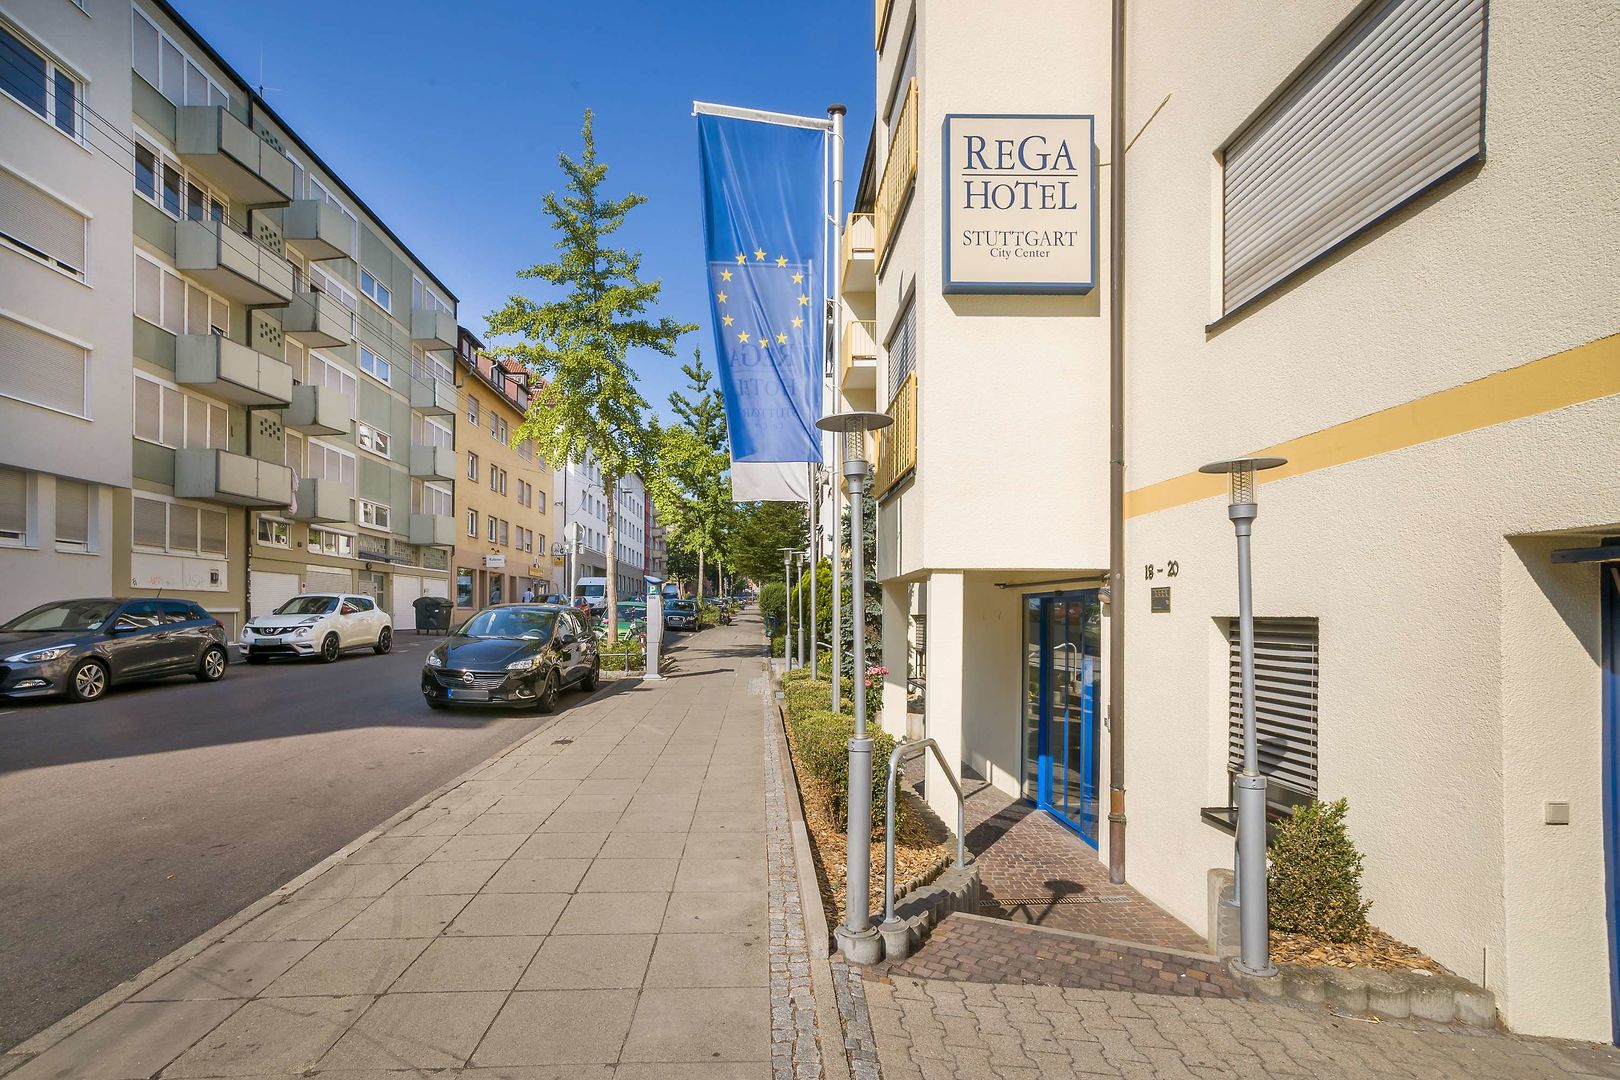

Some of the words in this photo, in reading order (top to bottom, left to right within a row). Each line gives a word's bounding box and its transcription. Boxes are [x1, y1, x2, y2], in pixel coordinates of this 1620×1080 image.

[963, 135, 1077, 171] REGA
[963, 180, 1078, 210] HOTEL
[962, 230, 1078, 247] STUTTGART
[990, 248, 1011, 260] City
[1014, 248, 1050, 258] Center
[1144, 564, 1154, 580] 18
[1167, 560, 1179, 577] 20
